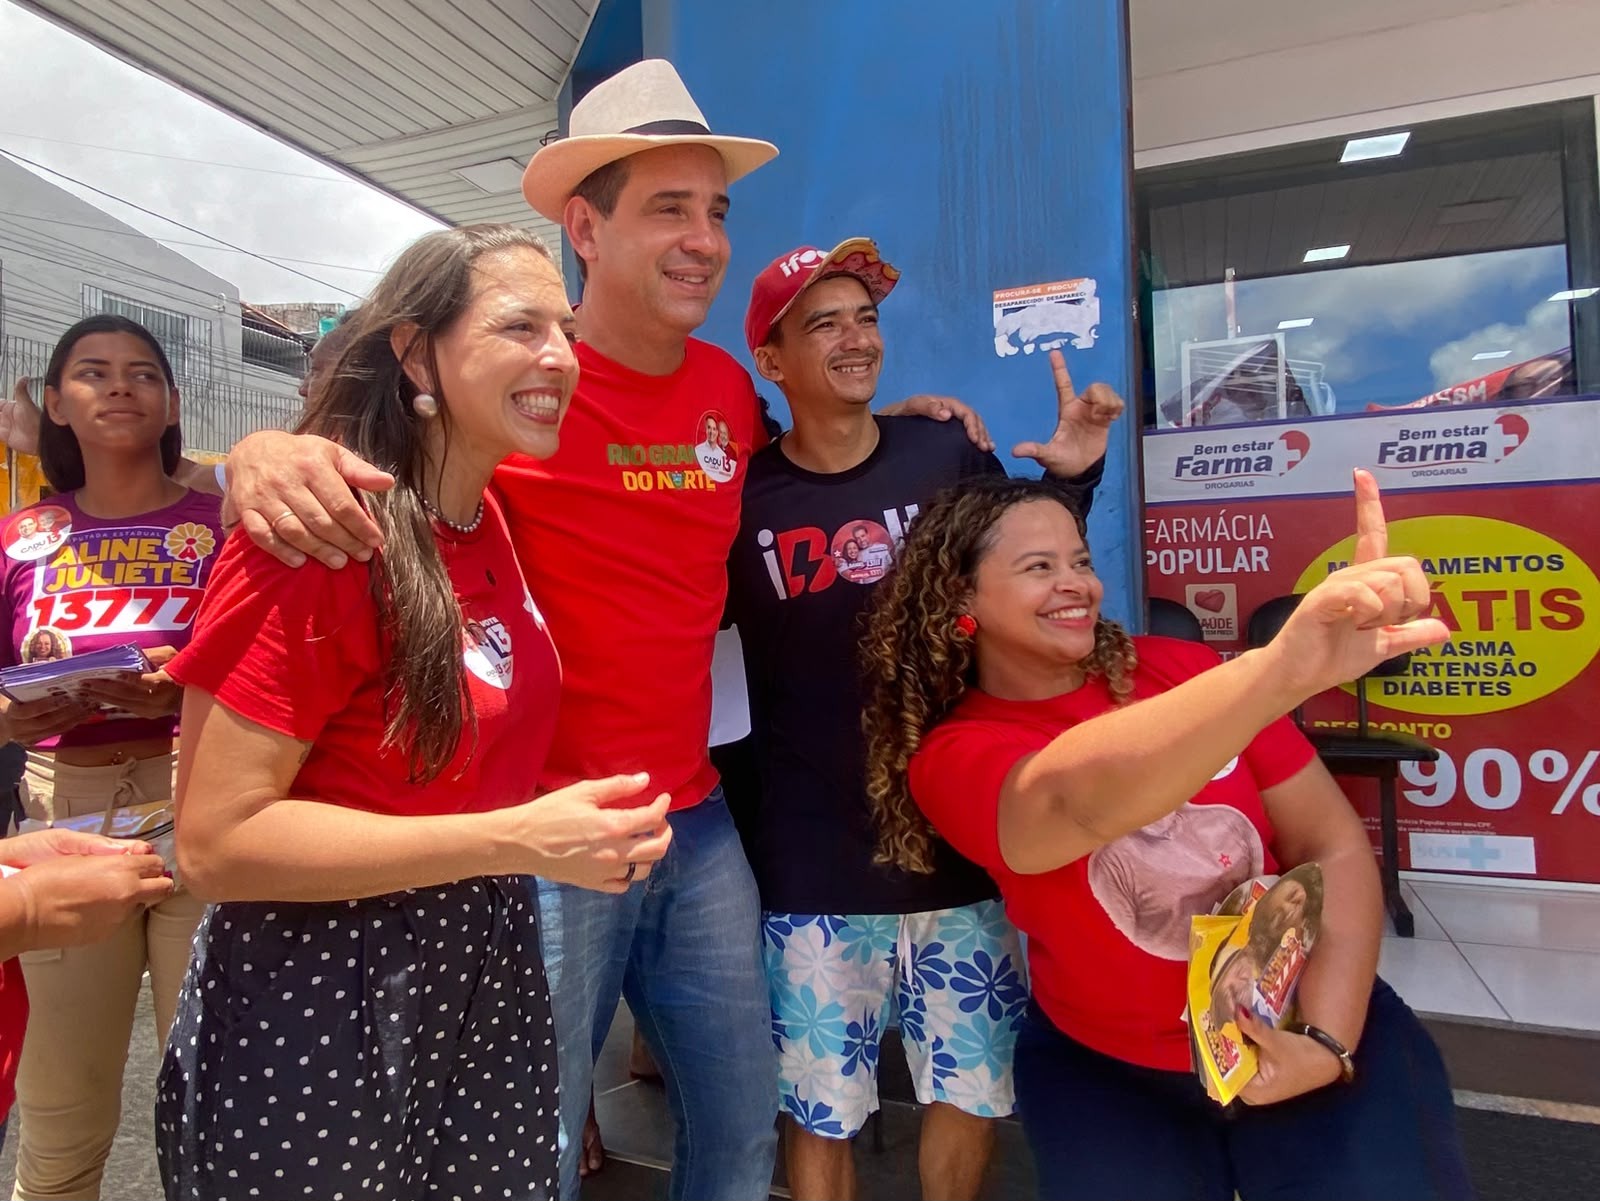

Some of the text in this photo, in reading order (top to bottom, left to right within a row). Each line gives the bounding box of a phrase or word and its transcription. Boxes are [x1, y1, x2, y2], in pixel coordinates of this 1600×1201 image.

[996, 282, 1082, 299] PROCURA-SE PROCUR
[1398, 425, 1489, 441] Bem estar
[607, 443, 646, 465] RIO
[1193, 440, 1275, 456] Bem estar
[1377, 439, 1488, 465] Farma
[1174, 455, 1273, 478] Farma
[1412, 467, 1468, 478] DROGARIAS
[622, 471, 653, 491] DO
[1204, 480, 1255, 490] DROGARIAS
[67, 530, 161, 543] PUTADA ESTADUAL
[1145, 509, 1274, 544] FARMÁCIA
[50, 538, 159, 568] ALINE
[1146, 546, 1270, 575] POPULAR
[1327, 554, 1565, 575] MAMENTOS
[46, 561, 195, 593] JULIETE
[34, 587, 206, 631] 13777
[1416, 581, 1585, 633] ÁTIS
[1200, 616, 1233, 630] AÚDE
[1440, 641, 1516, 657] ASMA
[1401, 658, 1538, 677] RTENSÃO
[1383, 680, 1512, 697] DIABETES
[1400, 747, 1600, 816] 90%
